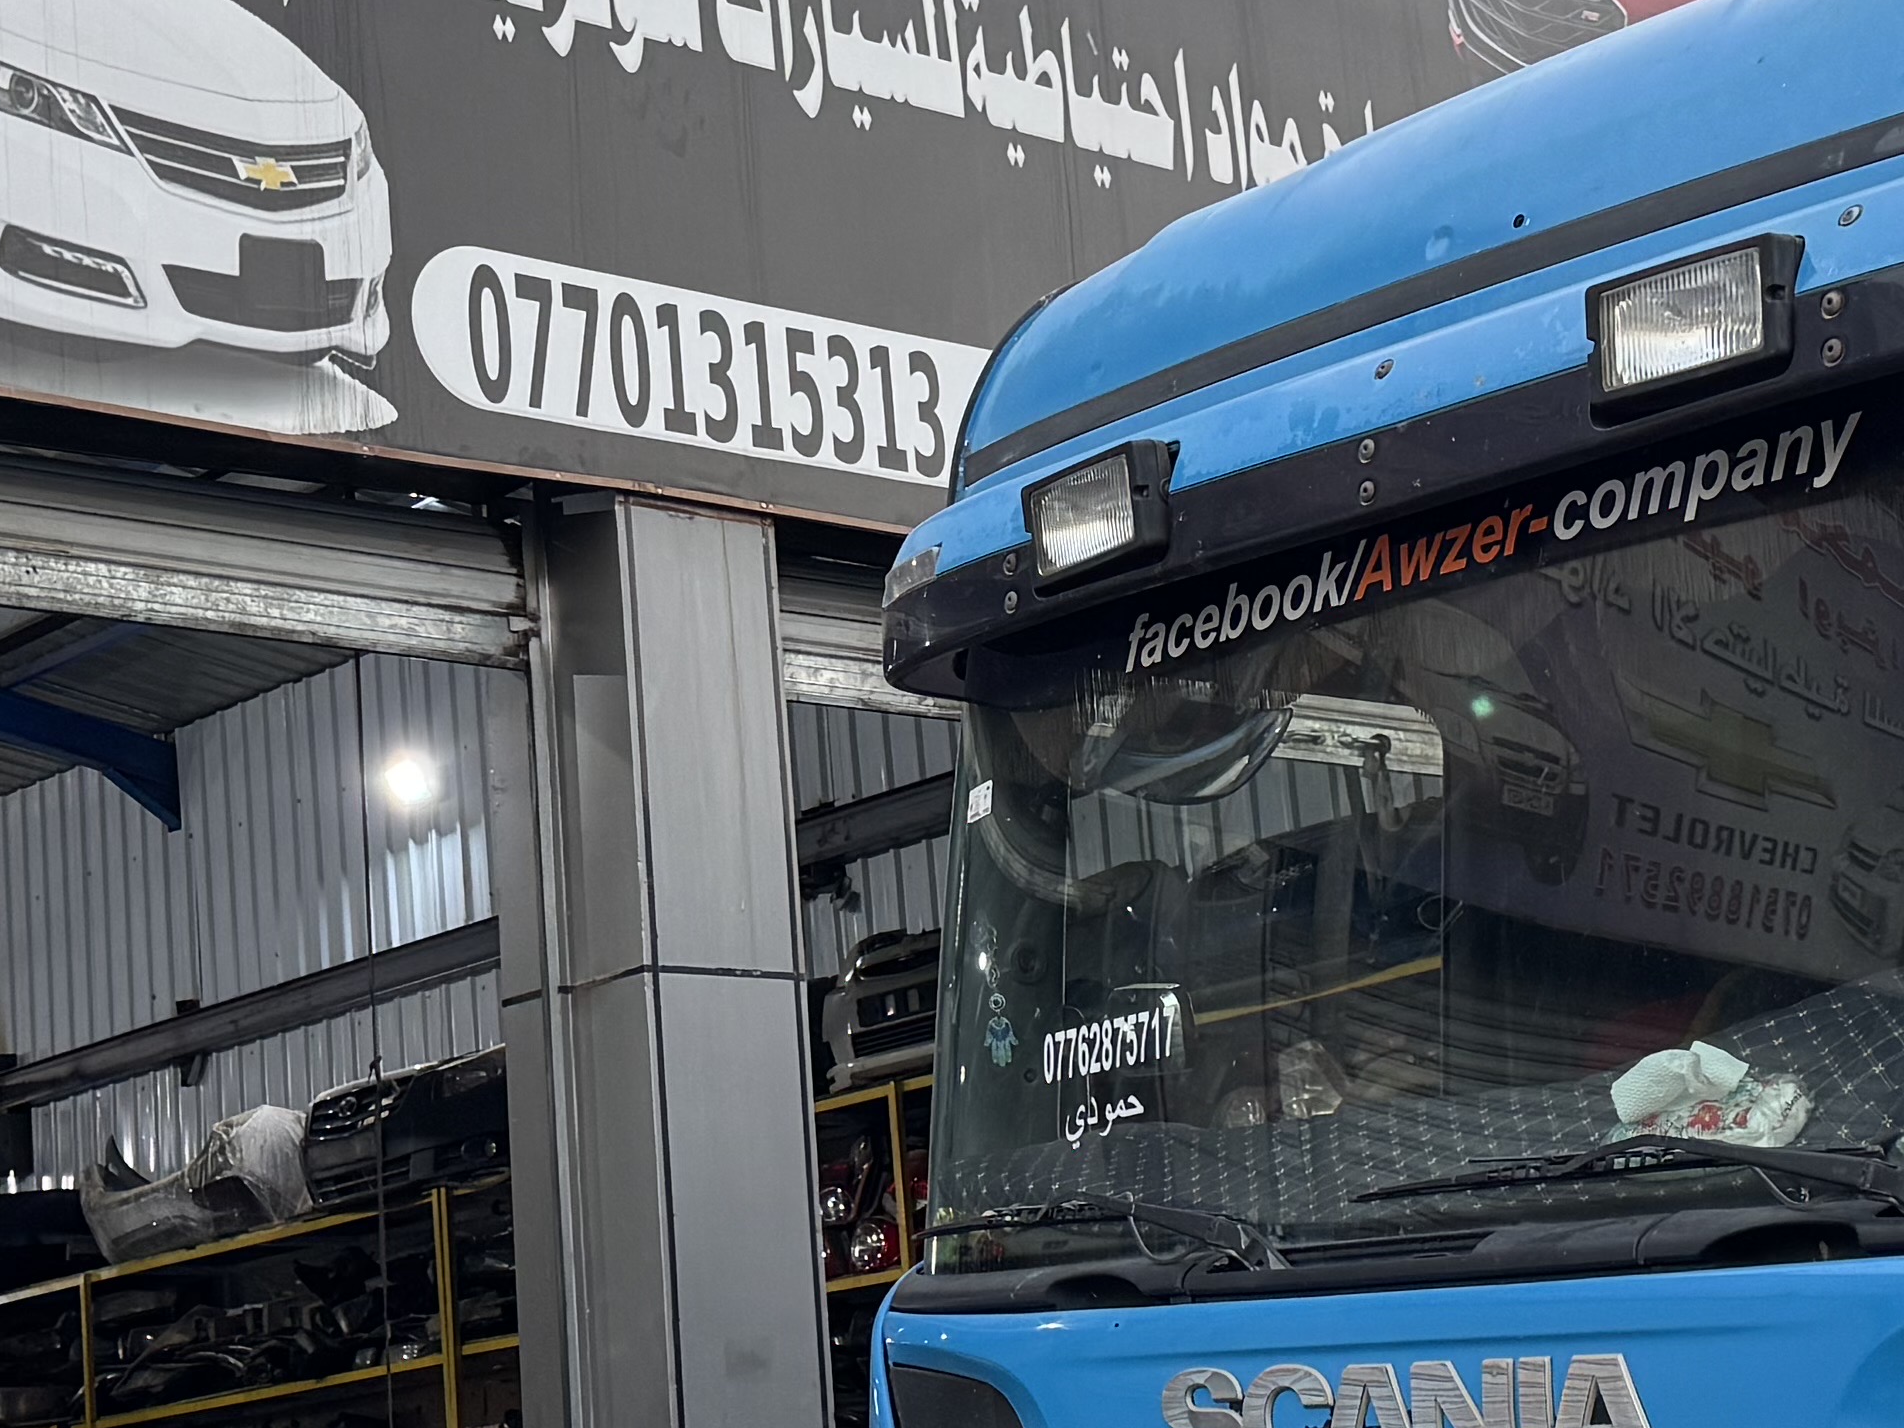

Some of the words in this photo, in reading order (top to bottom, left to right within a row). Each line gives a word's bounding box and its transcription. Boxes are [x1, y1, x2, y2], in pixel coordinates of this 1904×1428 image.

[468, 263, 946, 479] 07701315313
[1043, 1005, 1175, 1084] 07762875717
[1065, 1091, 1145, 1150] حمودي
